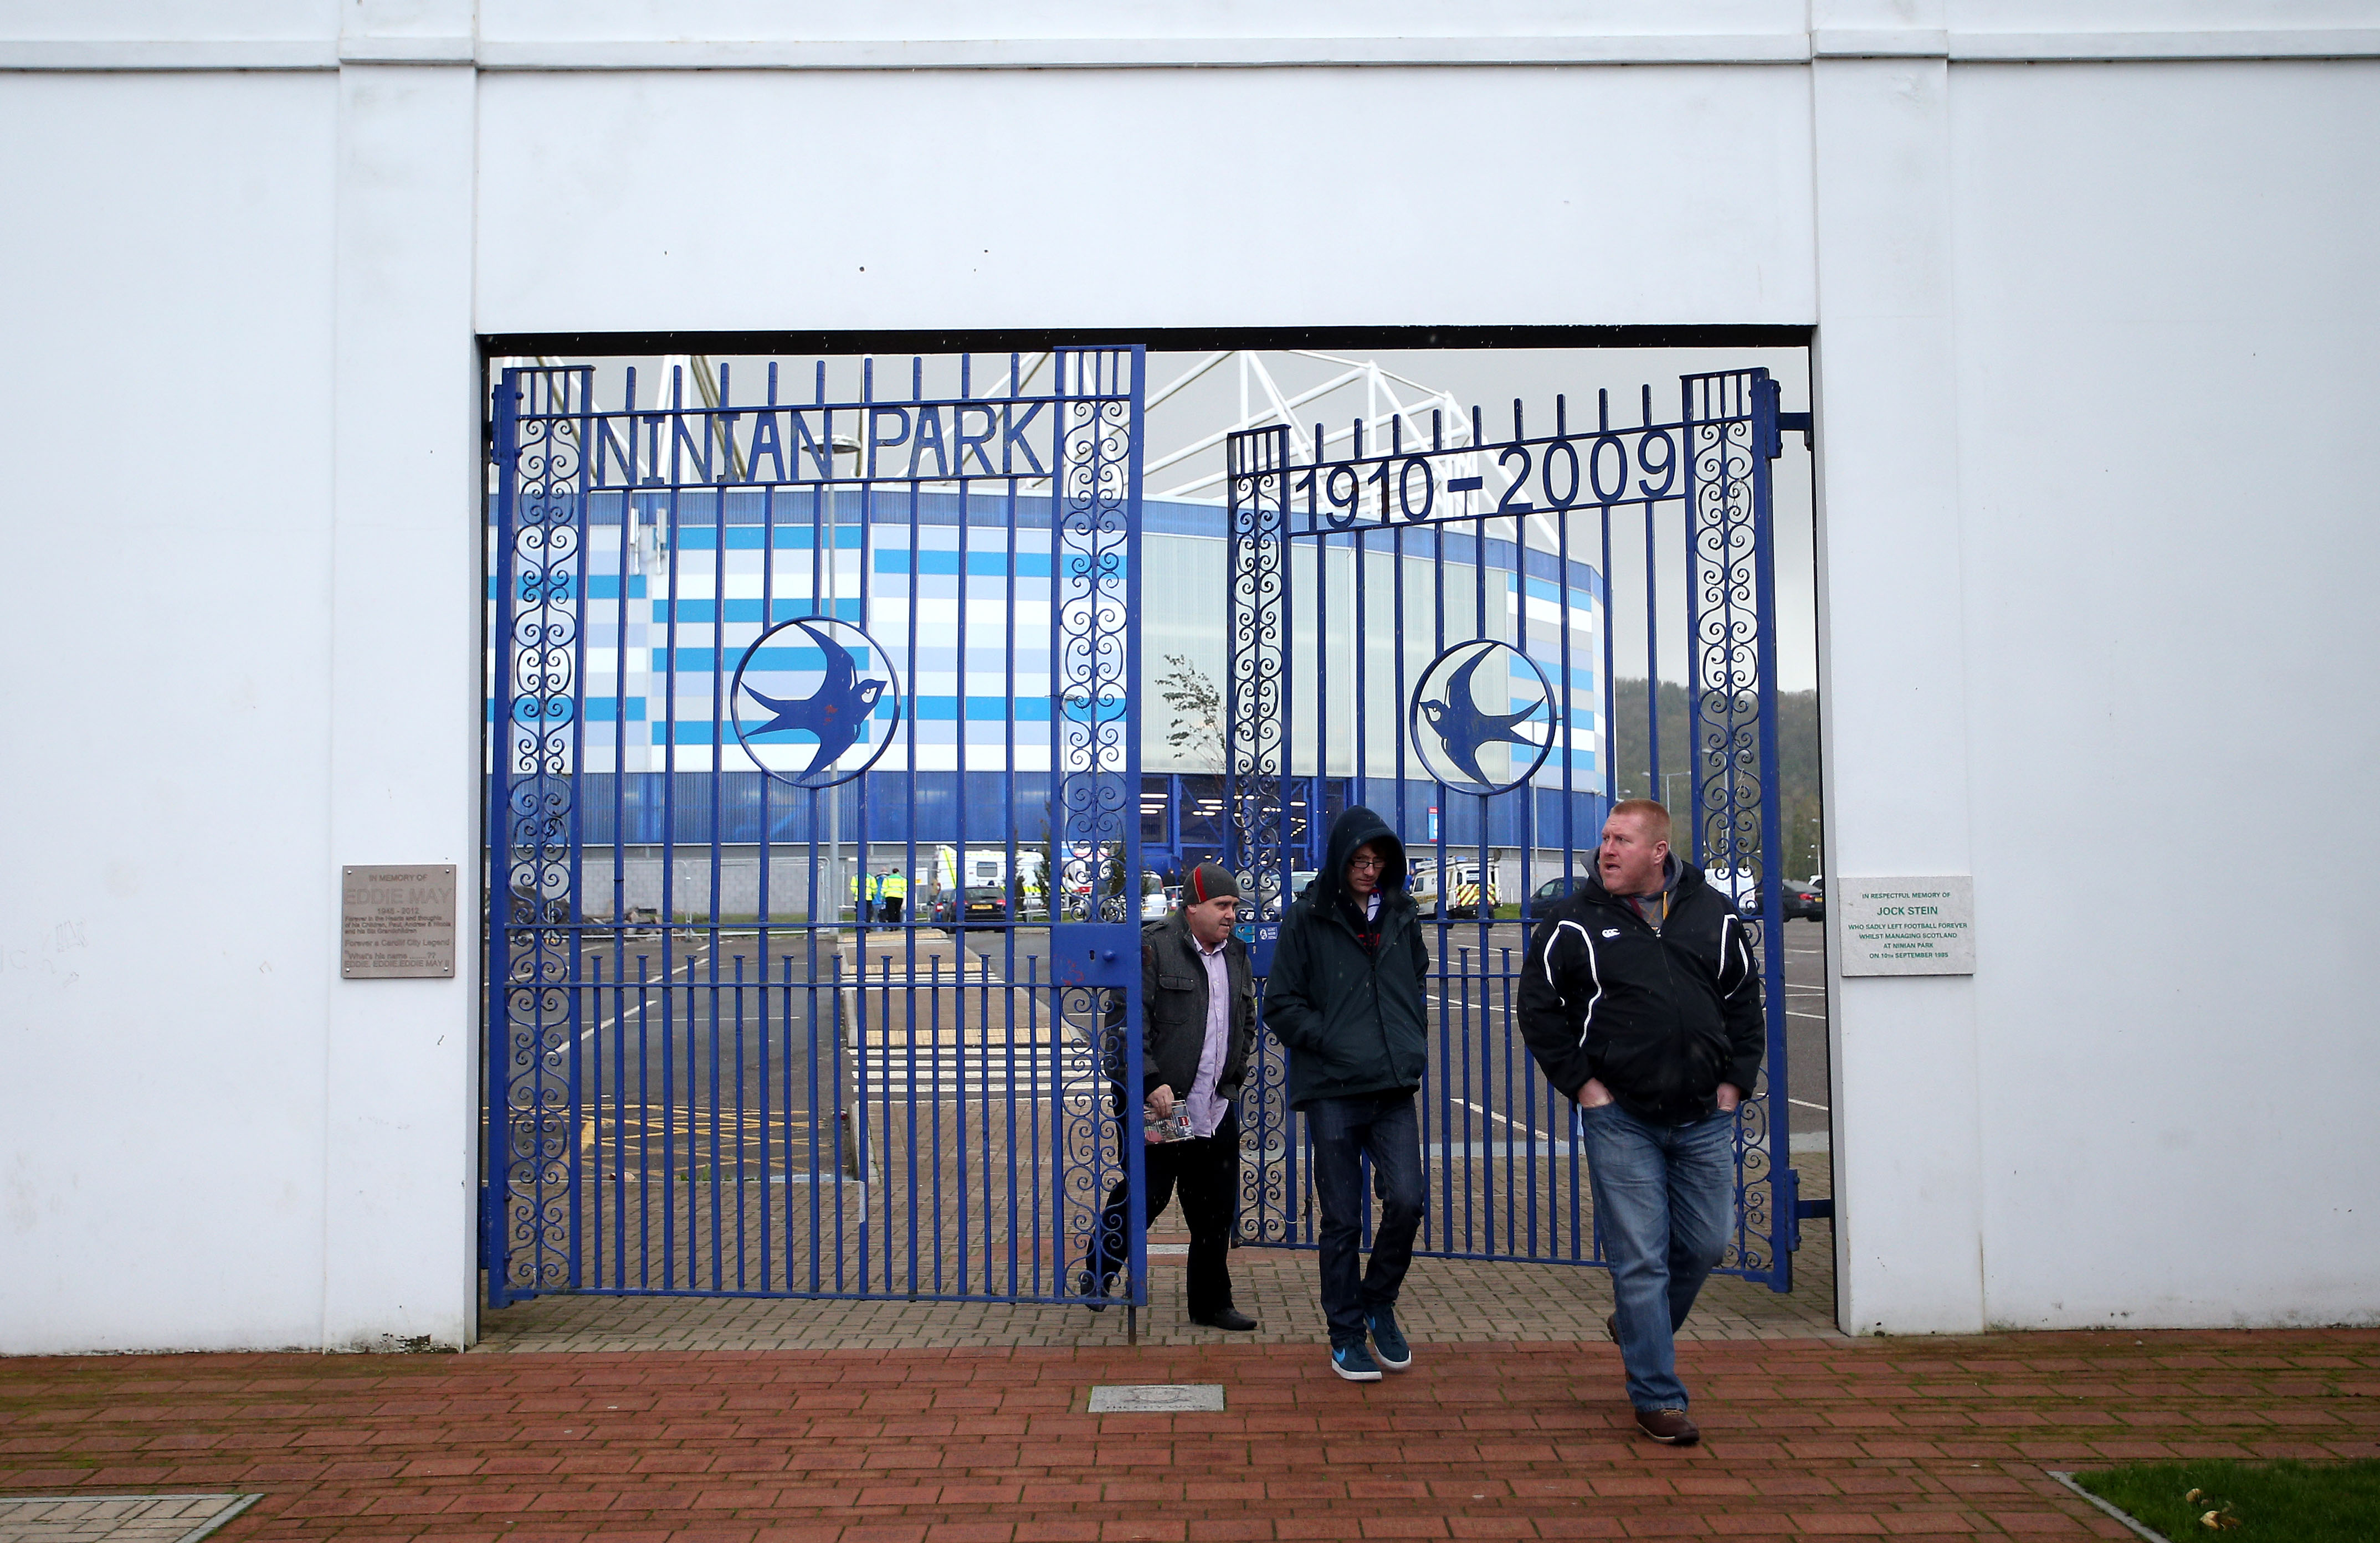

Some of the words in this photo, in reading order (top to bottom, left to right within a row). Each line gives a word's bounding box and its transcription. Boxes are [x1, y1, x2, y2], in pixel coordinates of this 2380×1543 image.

[597, 409, 832, 486] NINIAN
[869, 402, 1045, 477] PARK
[343, 888, 404, 905] EDDIE
[409, 887, 452, 904] MAY
[1877, 907, 1905, 915] JOCK
[1908, 906, 1938, 915] STEIN
[423, 939, 450, 947] Legend
